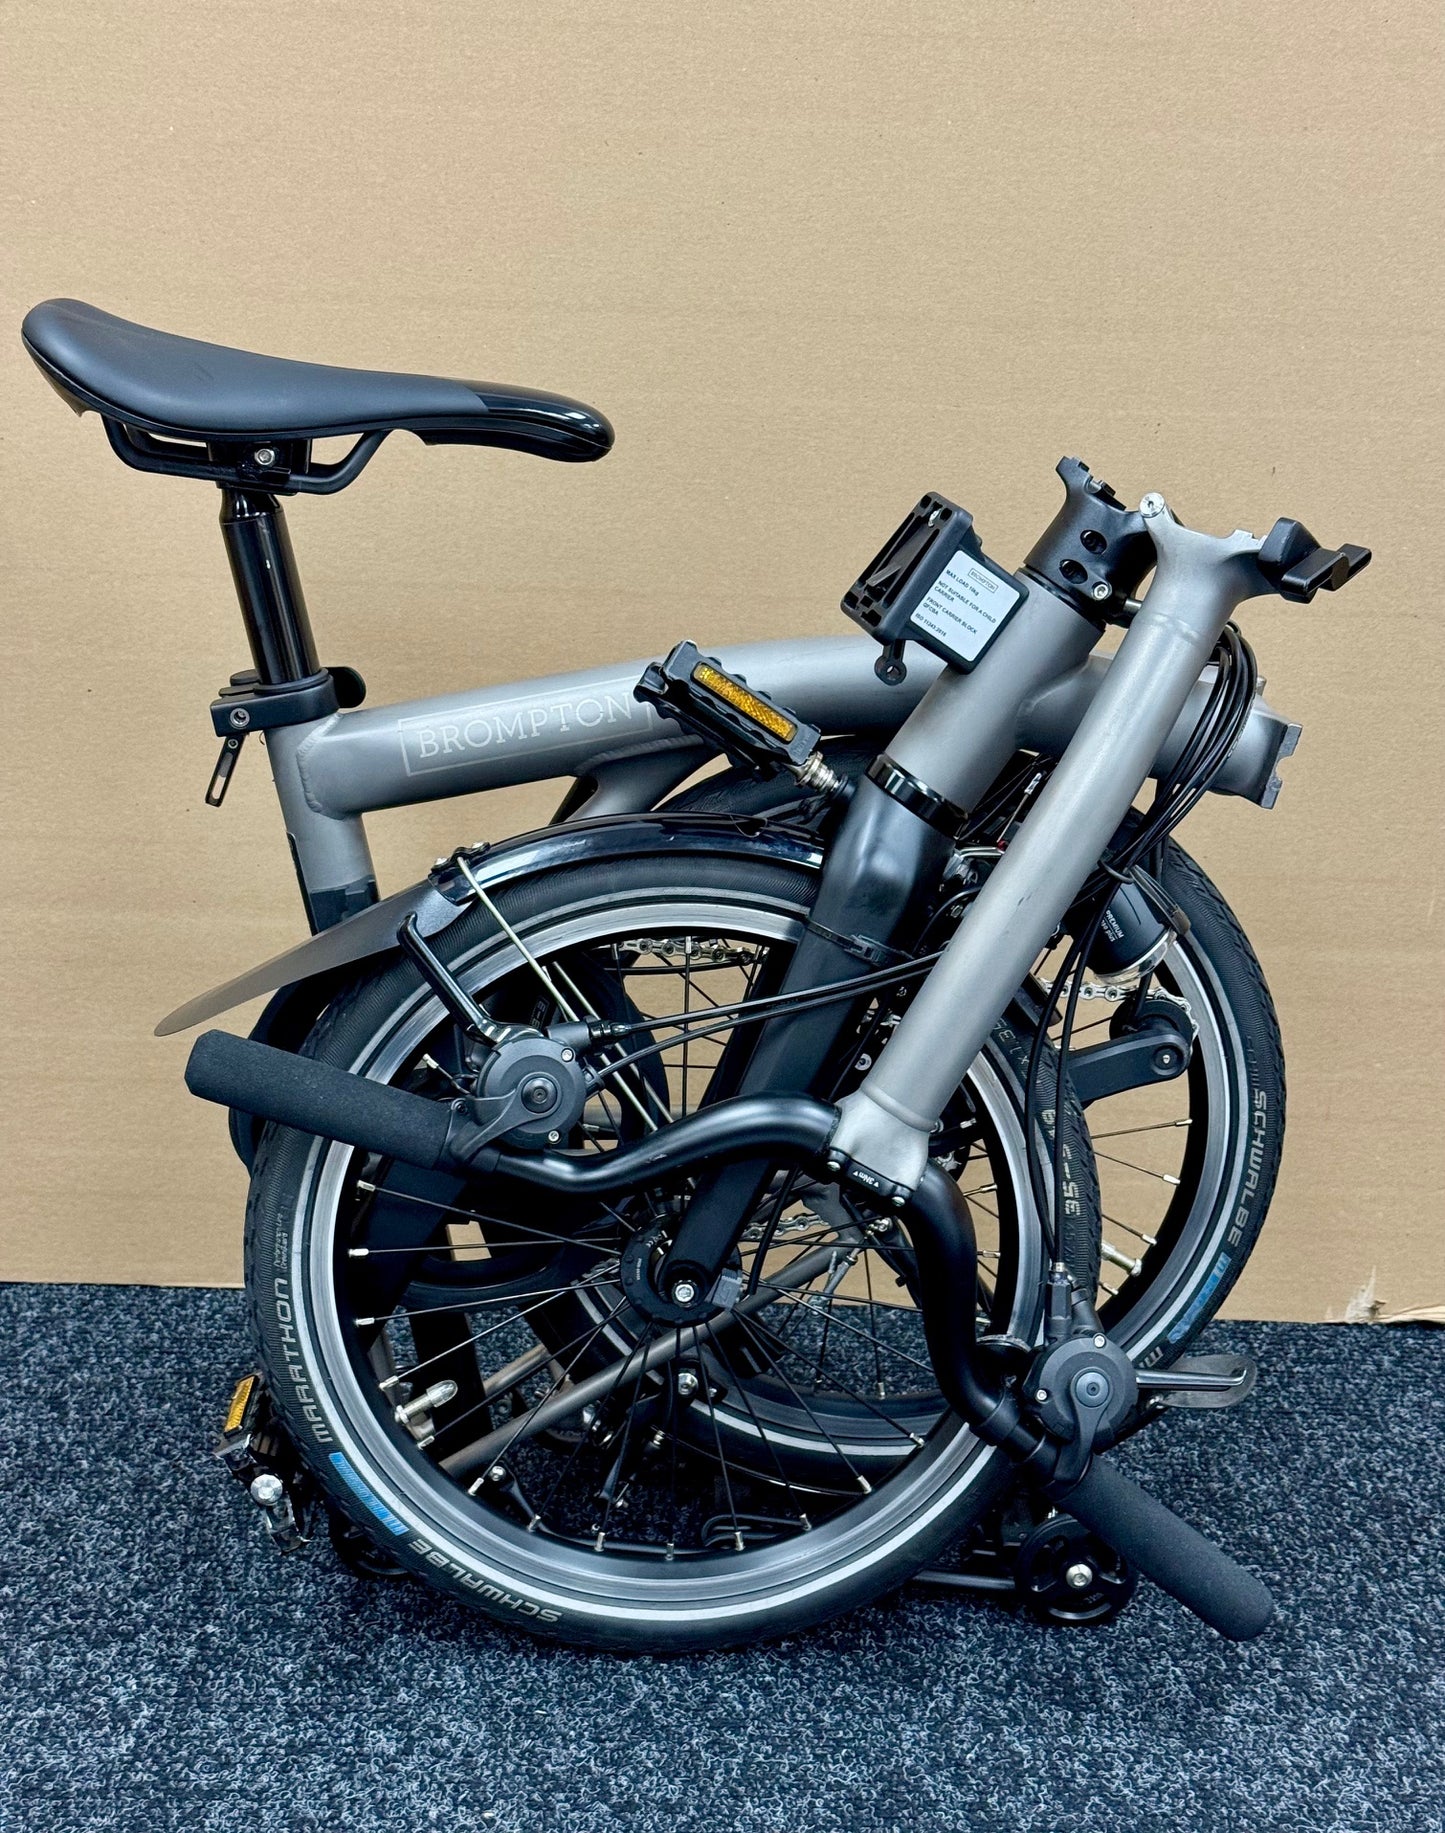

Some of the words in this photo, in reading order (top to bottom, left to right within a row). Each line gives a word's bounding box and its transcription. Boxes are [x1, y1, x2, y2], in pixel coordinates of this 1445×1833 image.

[934, 586, 955, 602] CARRIER
[945, 570, 956, 579] MAX
[955, 577, 969, 588] LOAD
[971, 571, 995, 590] BROMPTON
[915, 613, 924, 621] ISO
[926, 597, 942, 610] FRONT
[941, 607, 962, 624] CARRIER
[961, 621, 977, 634] BLOCK
[937, 581, 948, 590] NOT
[947, 588, 969, 605] SUITABLE
[968, 602, 979, 612] FOR
[982, 611, 997, 624] CHILD
[418, 691, 632, 759] BROMPTON
[1106, 910, 1124, 939] PREMIUM
[1227, 1091, 1267, 1247] SCHWALBE
[274, 1278, 333, 1444] MARATHON
[408, 1539, 563, 1623] SCHWALBE
